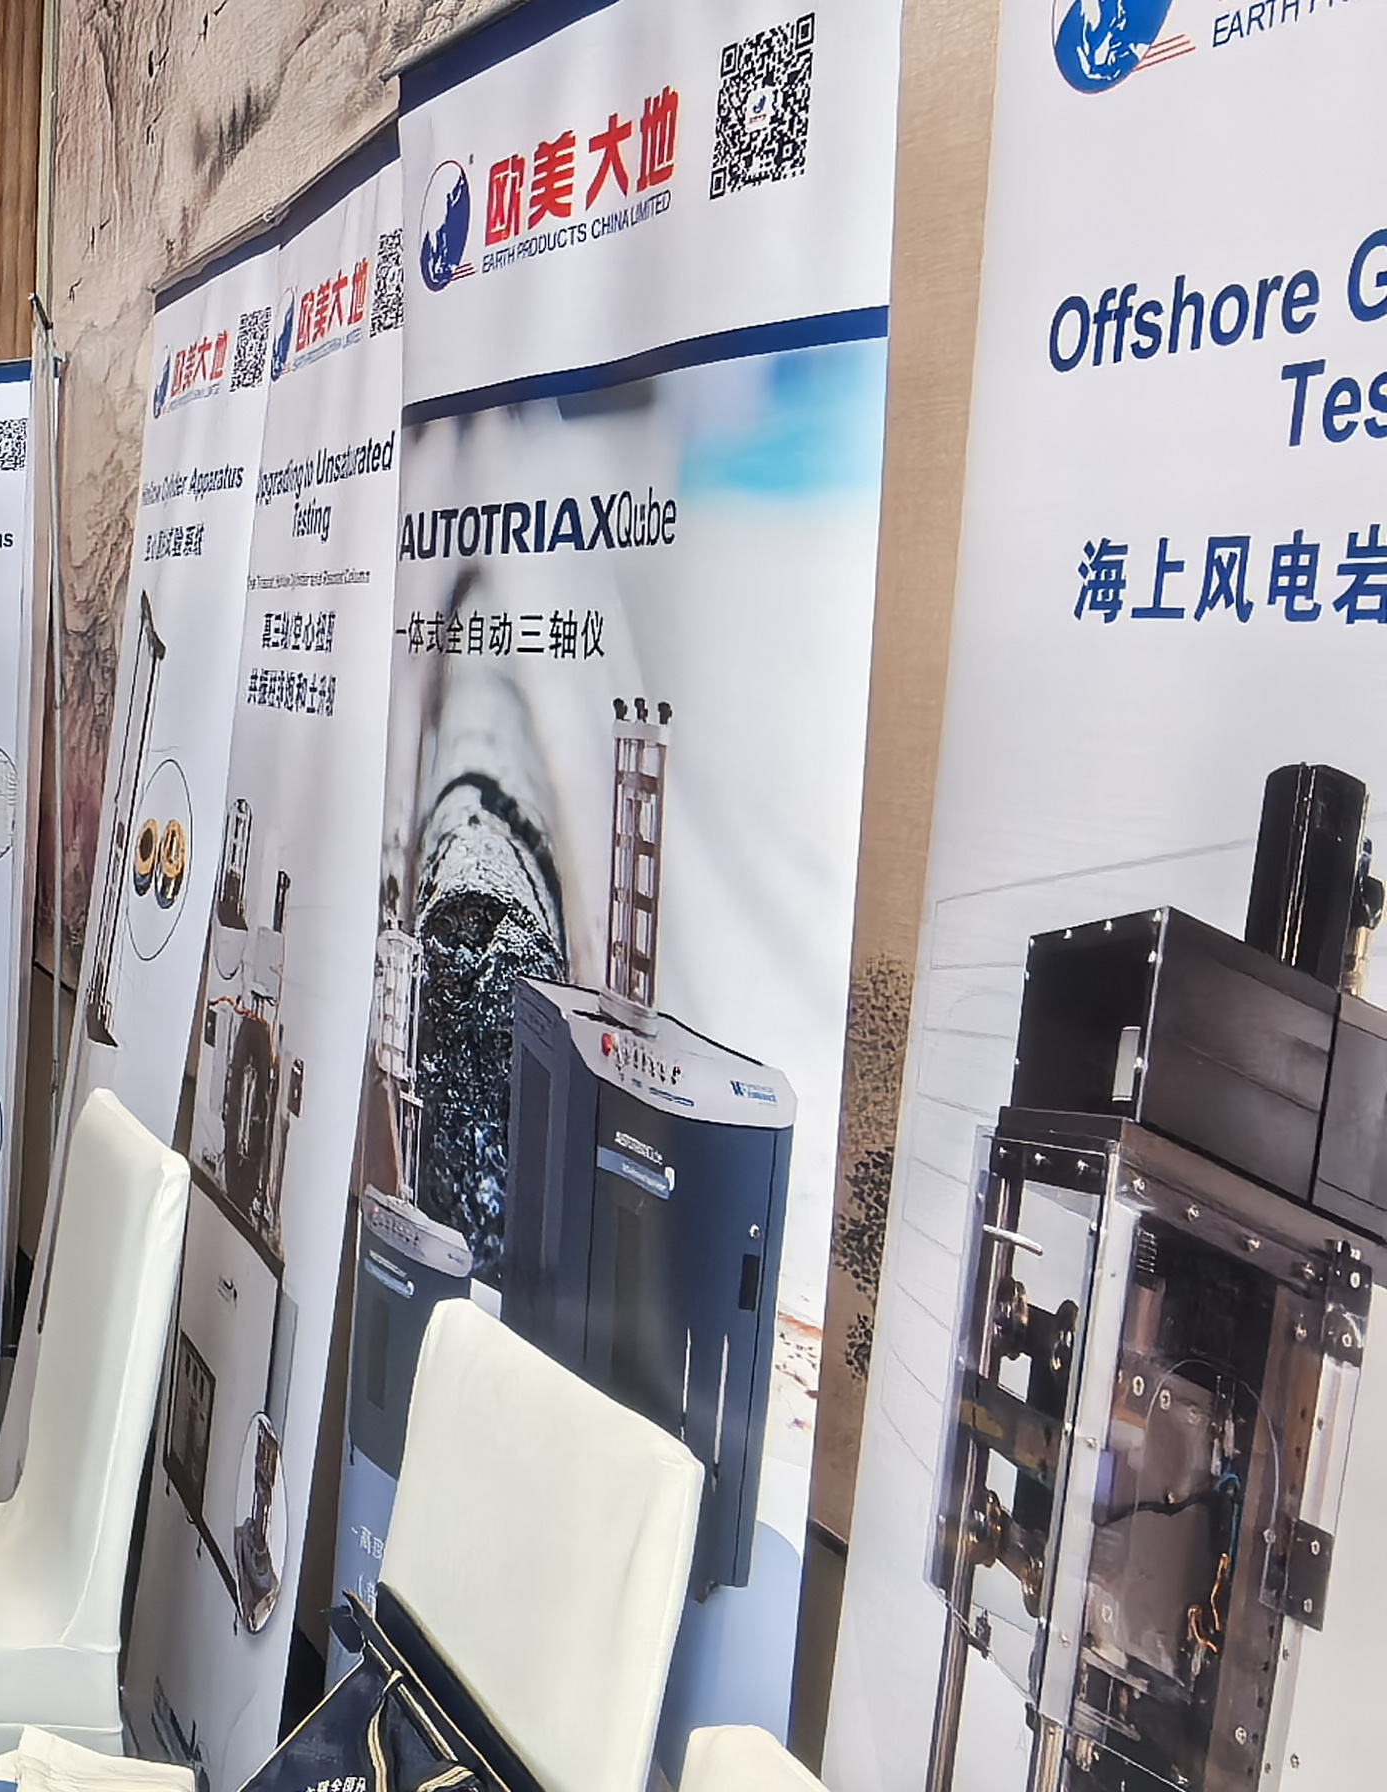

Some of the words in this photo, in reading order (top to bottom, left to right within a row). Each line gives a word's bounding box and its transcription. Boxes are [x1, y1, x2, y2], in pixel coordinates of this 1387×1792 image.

[1212, 0, 1300, 47] EARTH
[484, 85, 680, 247] 欧美大地
[481, 247, 516, 274] EARTH
[516, 223, 587, 260] PRODUCTS
[295, 257, 370, 353] 欧美大地
[1048, 267, 1320, 373] Offshore
[1073, 522, 1387, 625] 海上风电岩
[395, 608, 606, 660] 一体式全自动三轴仪
